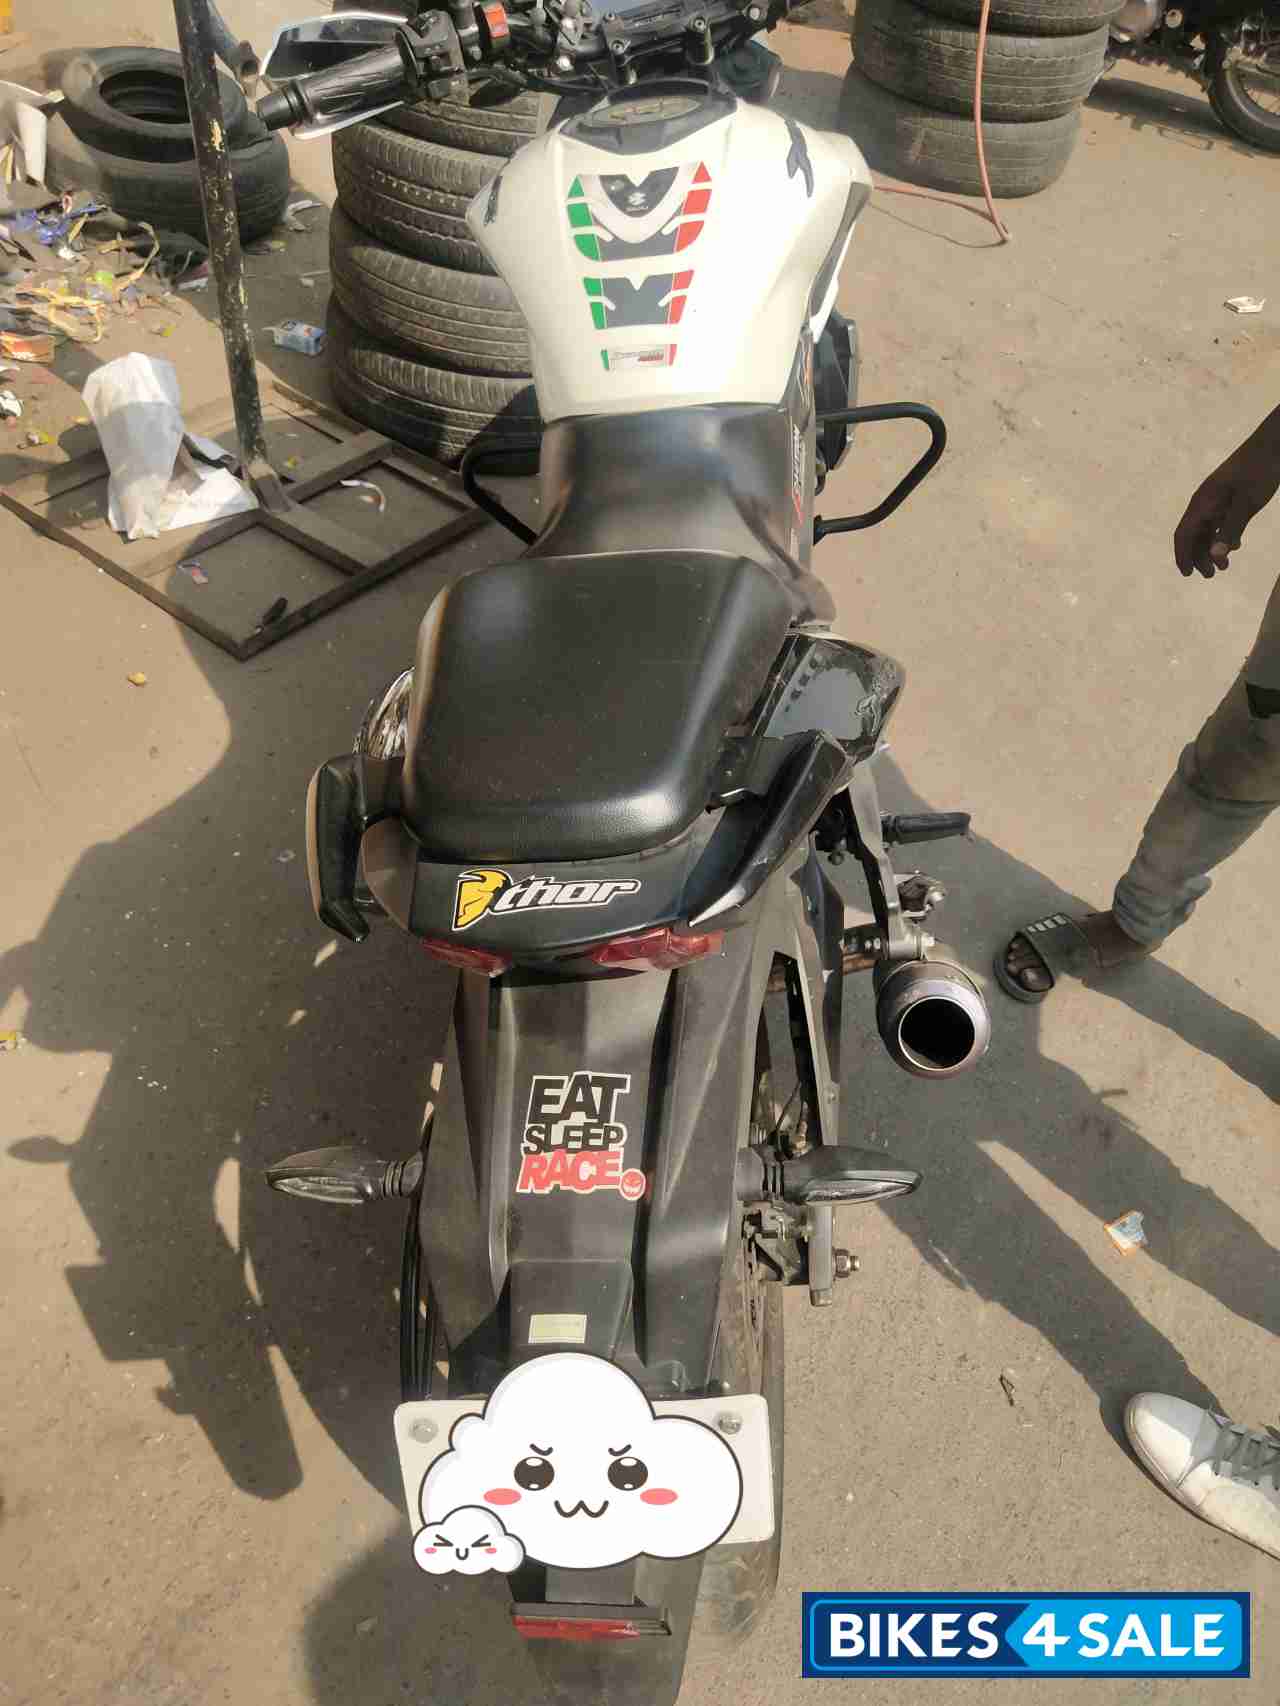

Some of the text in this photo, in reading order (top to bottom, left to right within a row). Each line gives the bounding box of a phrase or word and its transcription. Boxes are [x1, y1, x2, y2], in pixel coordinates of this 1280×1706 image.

[491, 877, 640, 914] thor
[527, 1072, 630, 1122] EAT
[523, 1123, 626, 1154] SLEEP
[518, 1149, 622, 1191] RACE
